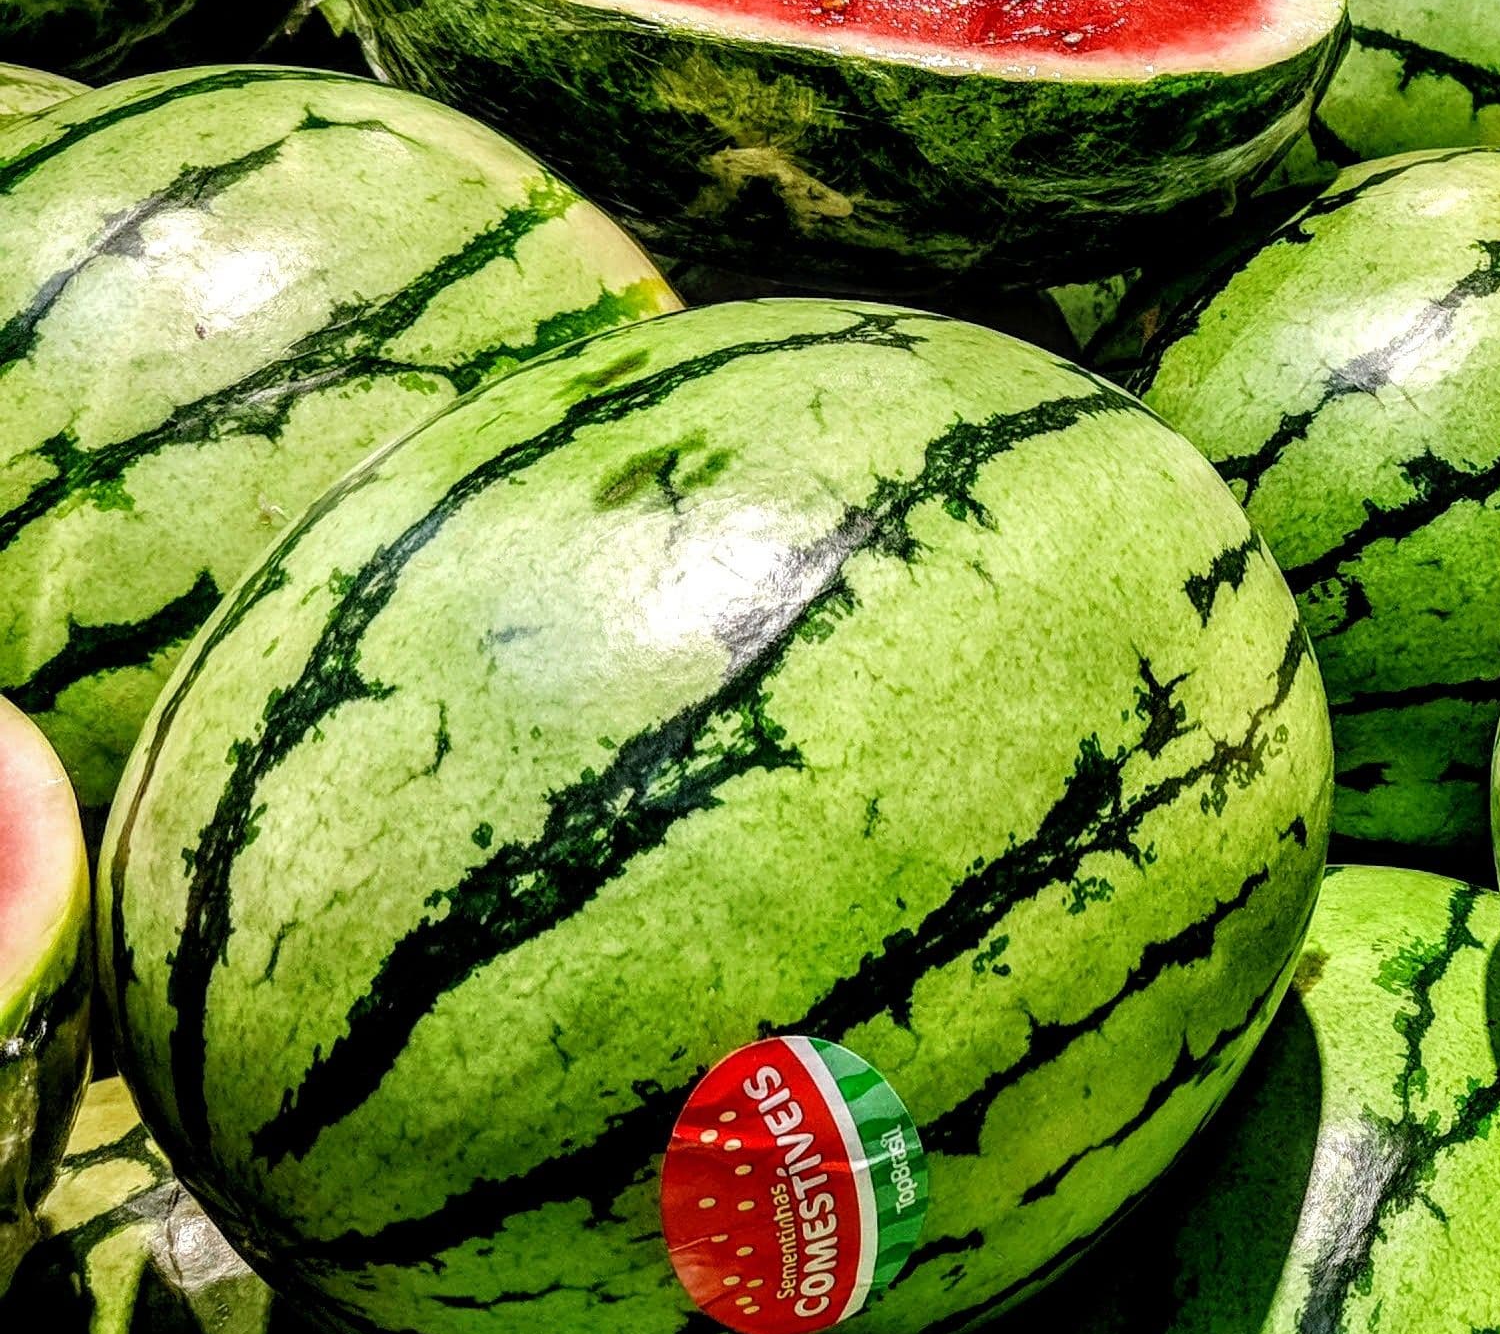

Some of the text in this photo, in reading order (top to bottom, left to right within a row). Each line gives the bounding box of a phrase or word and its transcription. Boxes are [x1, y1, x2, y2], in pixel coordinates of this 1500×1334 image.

[743, 1063, 839, 1318] COMESTÍVEIS
[880, 1124, 917, 1215] TopBrasil
[769, 1182, 800, 1300] Sementinhas
